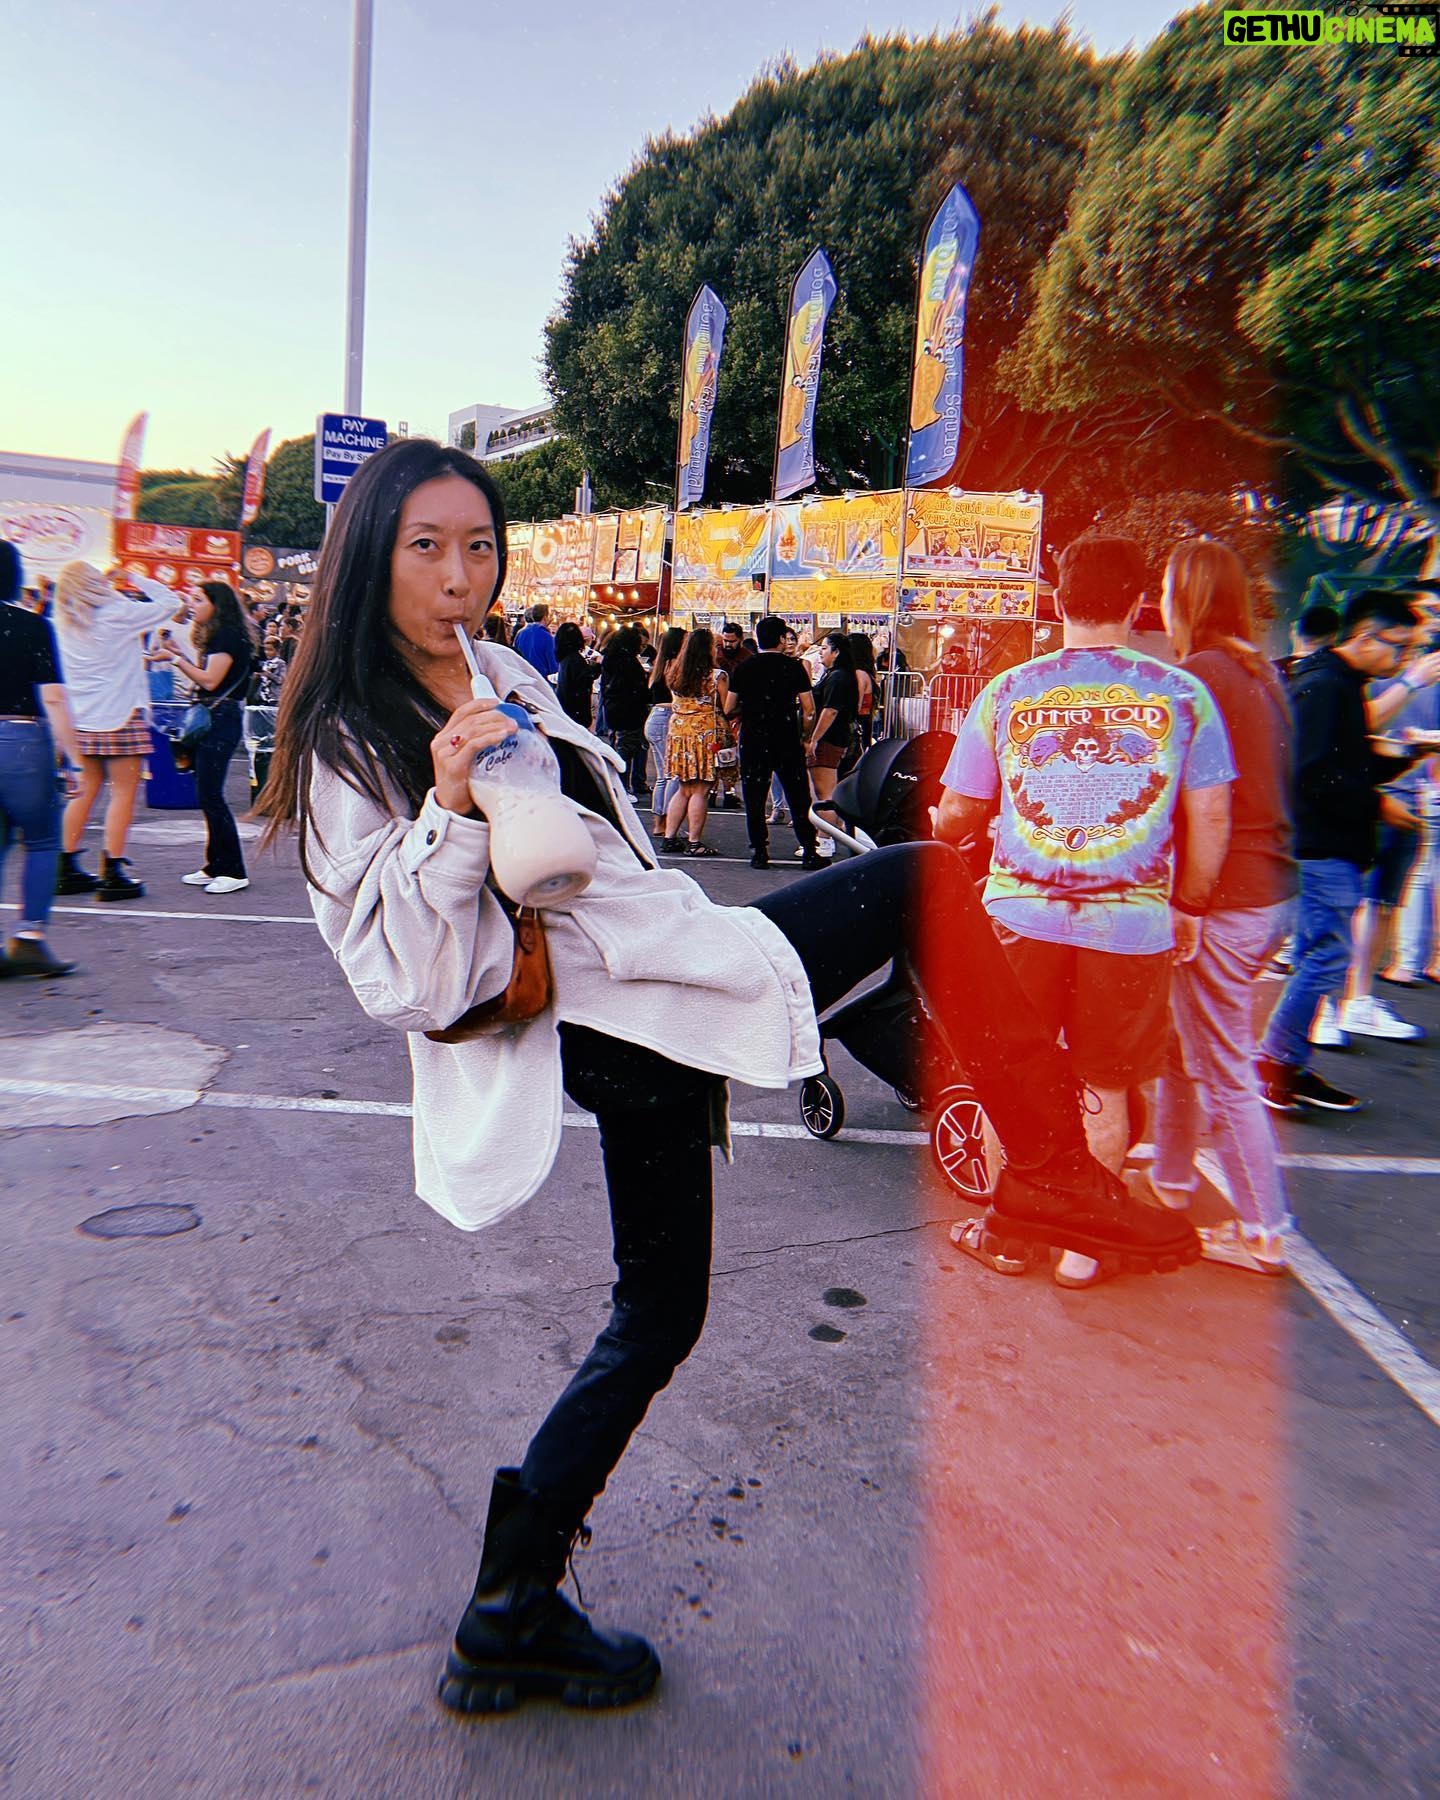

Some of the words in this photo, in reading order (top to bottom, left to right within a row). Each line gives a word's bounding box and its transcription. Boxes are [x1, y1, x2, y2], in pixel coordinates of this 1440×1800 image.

[342, 418, 368, 433] PAY
[943, 393, 963, 458] Squid
[324, 431, 385, 449] MACHINE
[326, 449, 341, 459] Pay
[344, 451, 355, 461] By
[687, 440, 706, 489] Squid
[277, 552, 312, 569] PORK
[913, 579, 929, 587] You
[1076, 690, 1103, 702] 2018
[1017, 707, 1093, 733] SUMMER
[1101, 707, 1162, 733] TOUR
